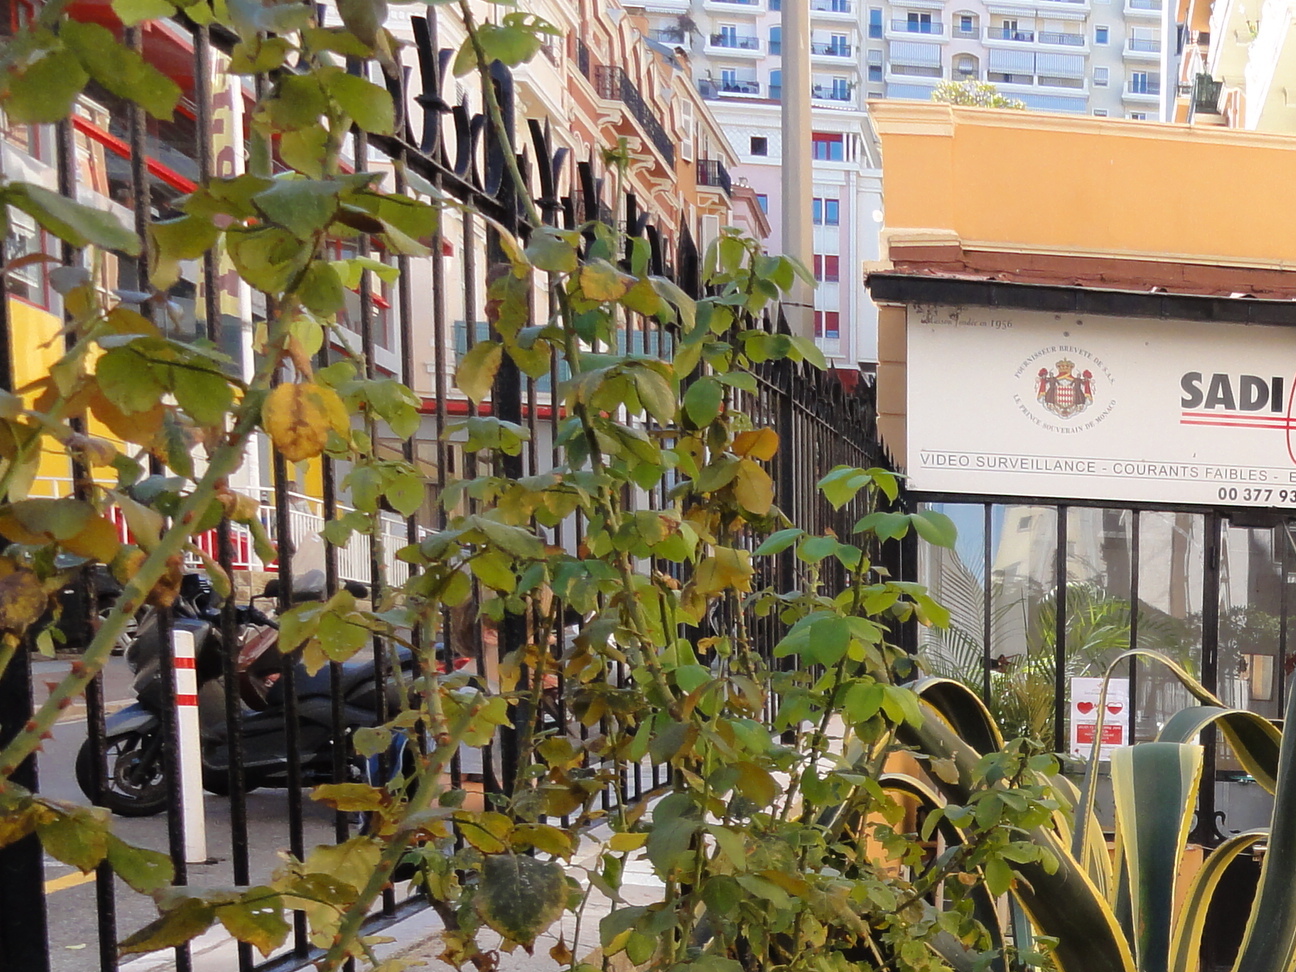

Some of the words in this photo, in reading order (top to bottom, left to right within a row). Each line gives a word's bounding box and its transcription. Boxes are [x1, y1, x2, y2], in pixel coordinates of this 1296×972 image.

[990, 319, 1013, 330] 1956
[1014, 346, 1057, 379] FOURNISSEUR
[1180, 371, 1284, 413] SADI
[1013, 394, 1021, 405] LE
[1019, 405, 1042, 426] PRINCE
[1043, 423, 1083, 434] SOUVERAIN
[1085, 421, 1095, 430] DE
[1095, 399, 1117, 424] MONACO
[920, 453, 970, 467] VIDEO
[976, 455, 1096, 473] SURVEILLANCE
[1113, 462, 1199, 478] COURANTS
[1205, 466, 1268, 482] FAIBLES
[1218, 487, 1238, 500] 00
[1243, 488, 1273, 502] 377
